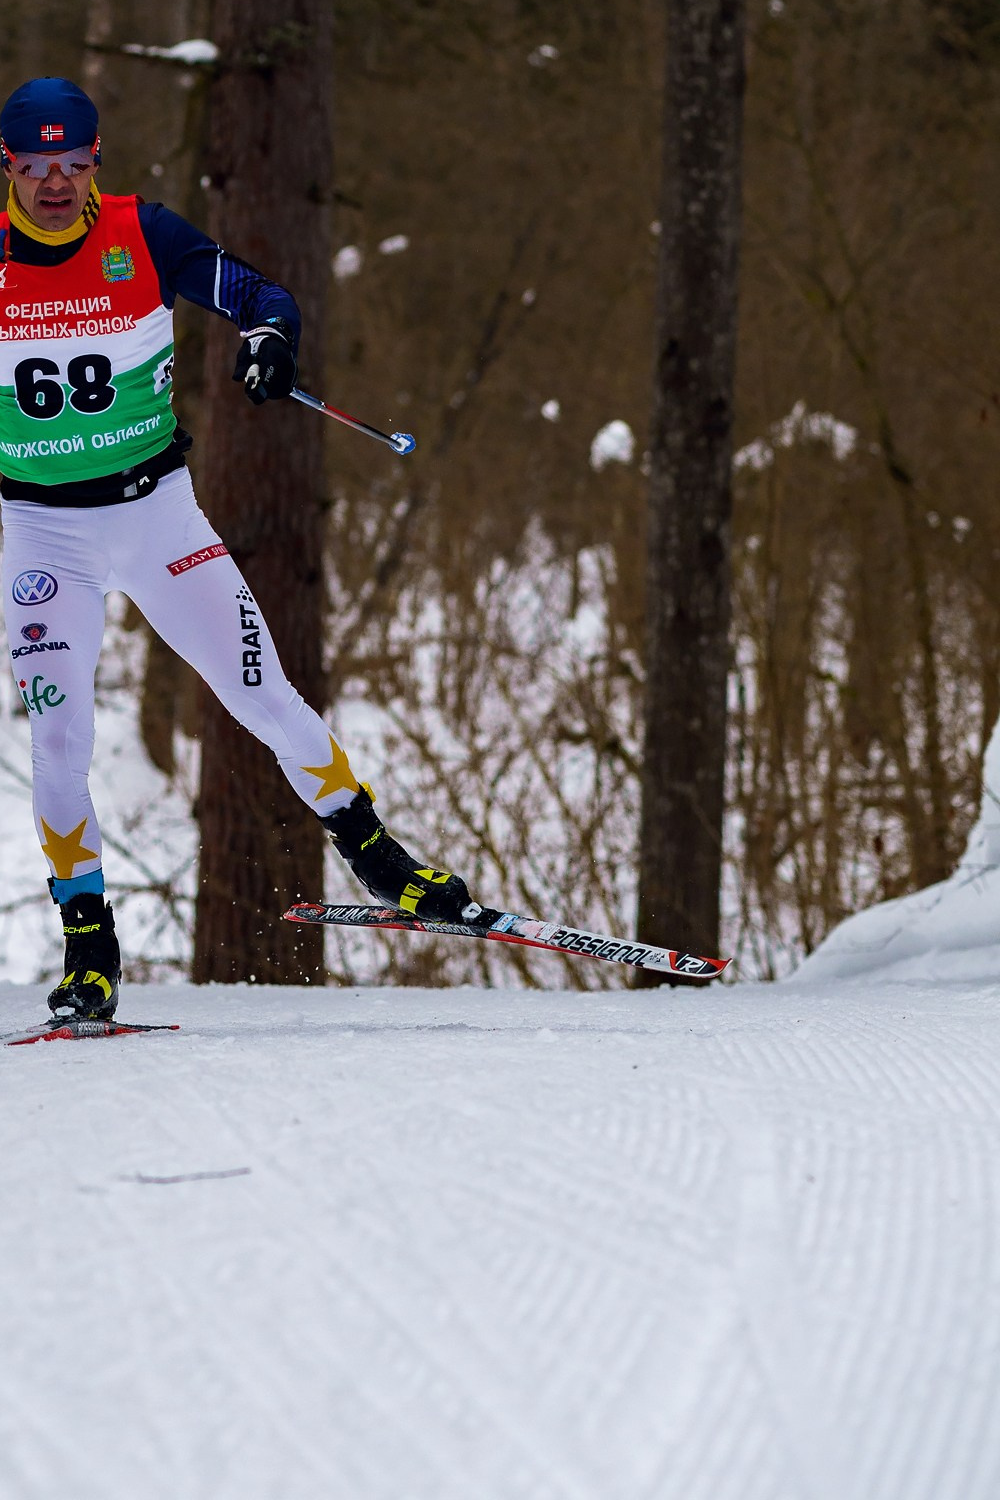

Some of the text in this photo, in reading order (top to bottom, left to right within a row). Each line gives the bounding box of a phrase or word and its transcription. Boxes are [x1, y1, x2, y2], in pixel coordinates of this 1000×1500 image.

[5, 296, 112, 320] ФЕДЕРАЦИЯ
[76, 315, 136, 336] ГОНОК
[14, 353, 117, 420] 68
[91, 414, 160, 449] ОБЛАСТИ
[170, 550, 212, 572] TEAM
[12, 641, 70, 659] SCANIA
[239, 604, 262, 687] CRAFT
[16, 675, 66, 715] ife
[64, 923, 100, 934] SCHER
